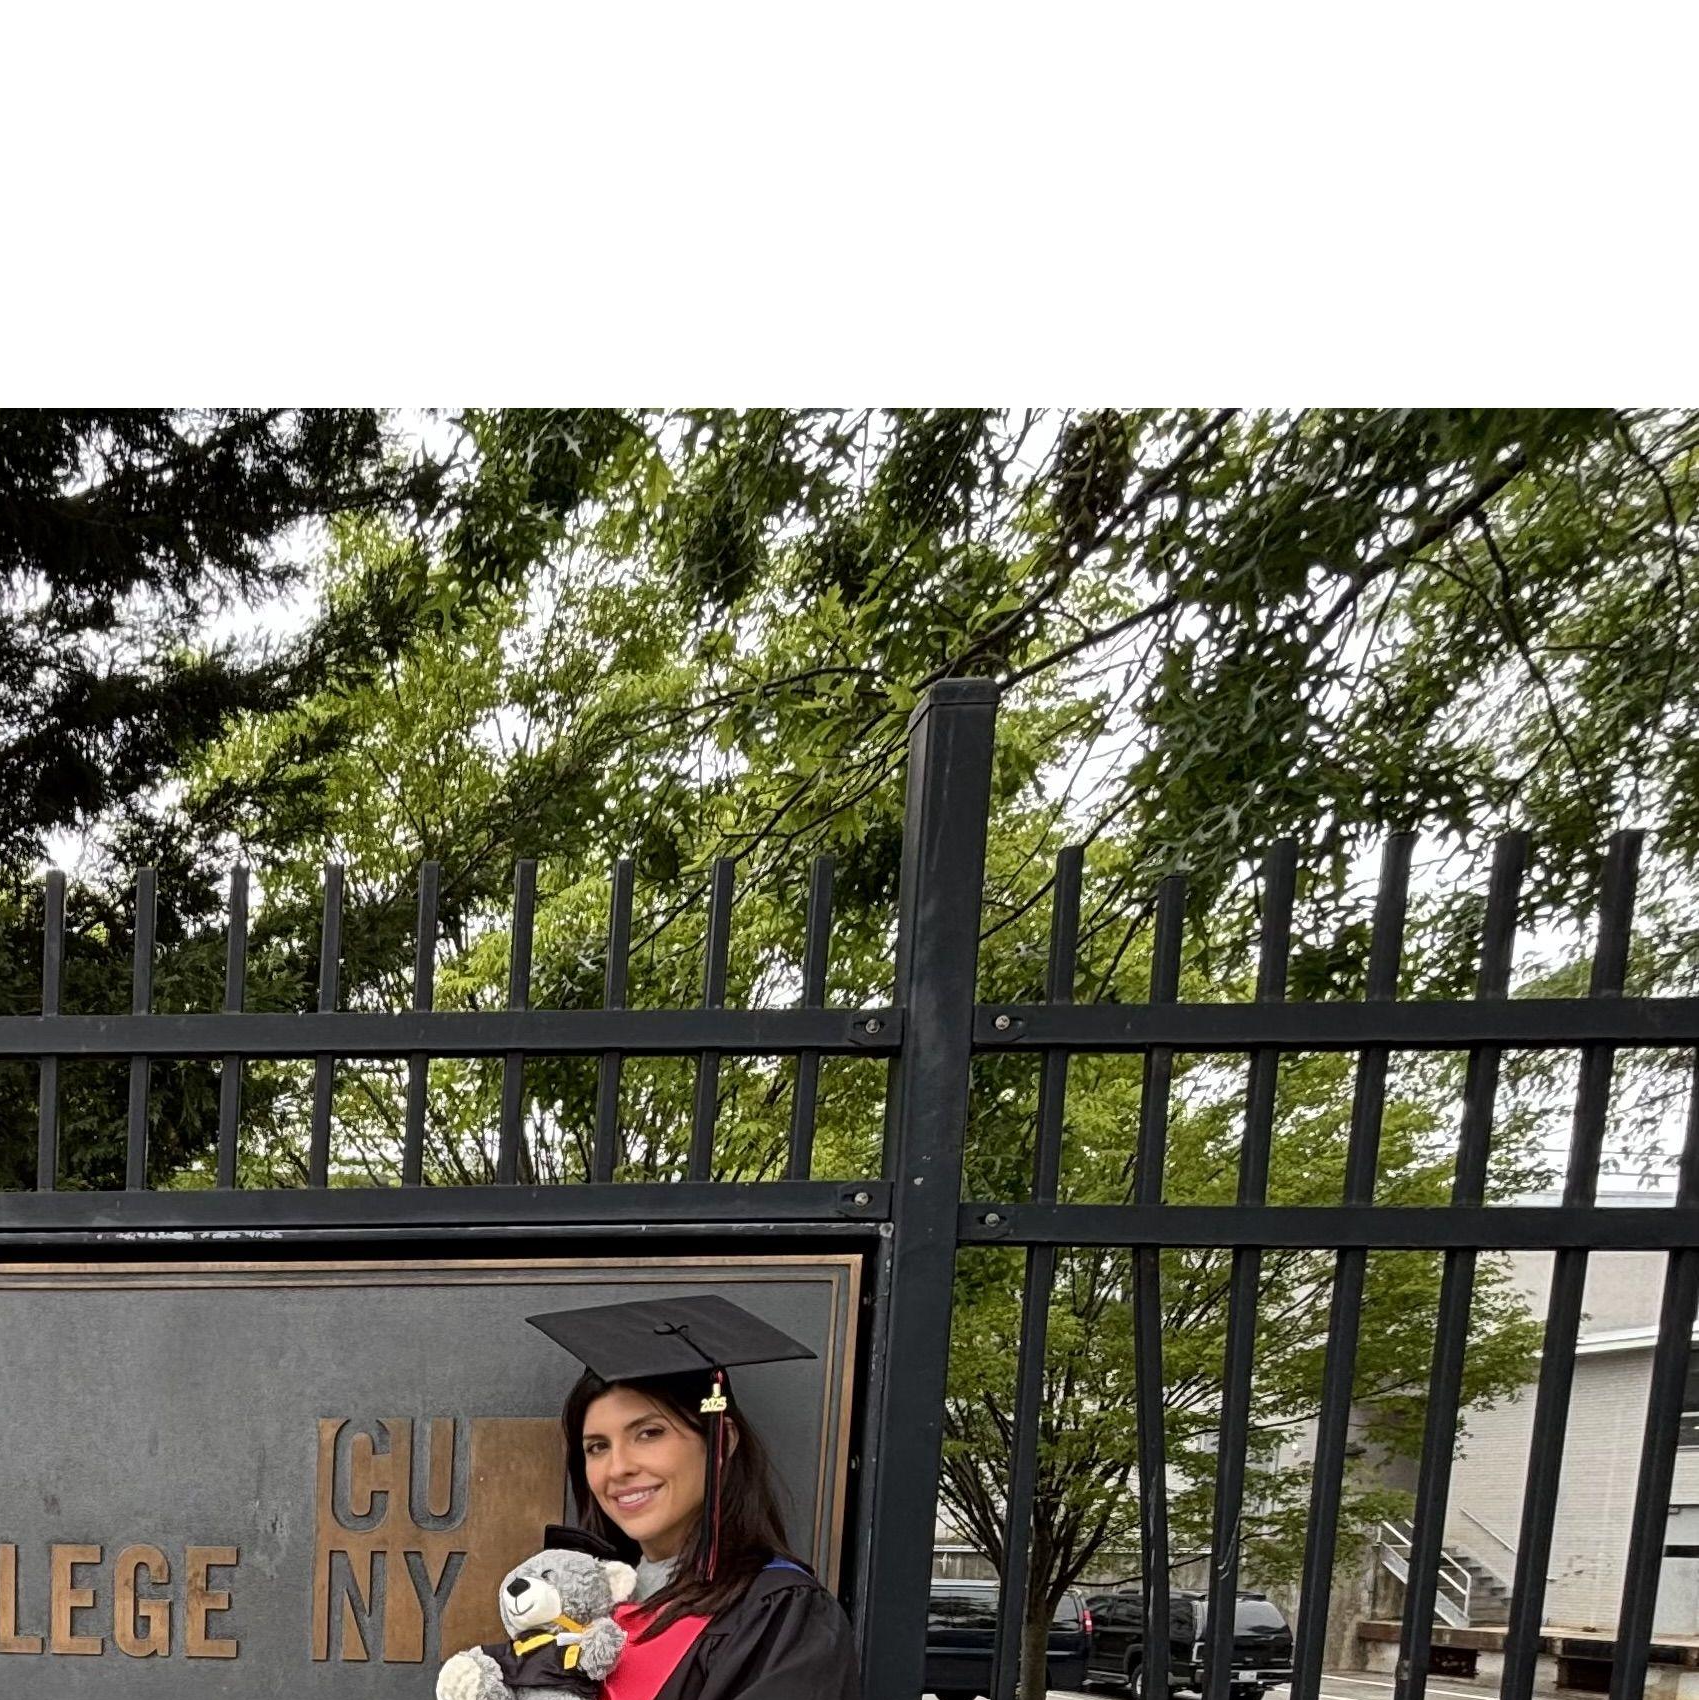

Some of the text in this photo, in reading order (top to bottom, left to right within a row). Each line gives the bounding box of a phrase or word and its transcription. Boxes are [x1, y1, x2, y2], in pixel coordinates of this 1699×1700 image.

[700, 1396, 727, 1413] 2025
[332, 1416, 470, 1532] CU
[326, 1550, 468, 1662] NY
